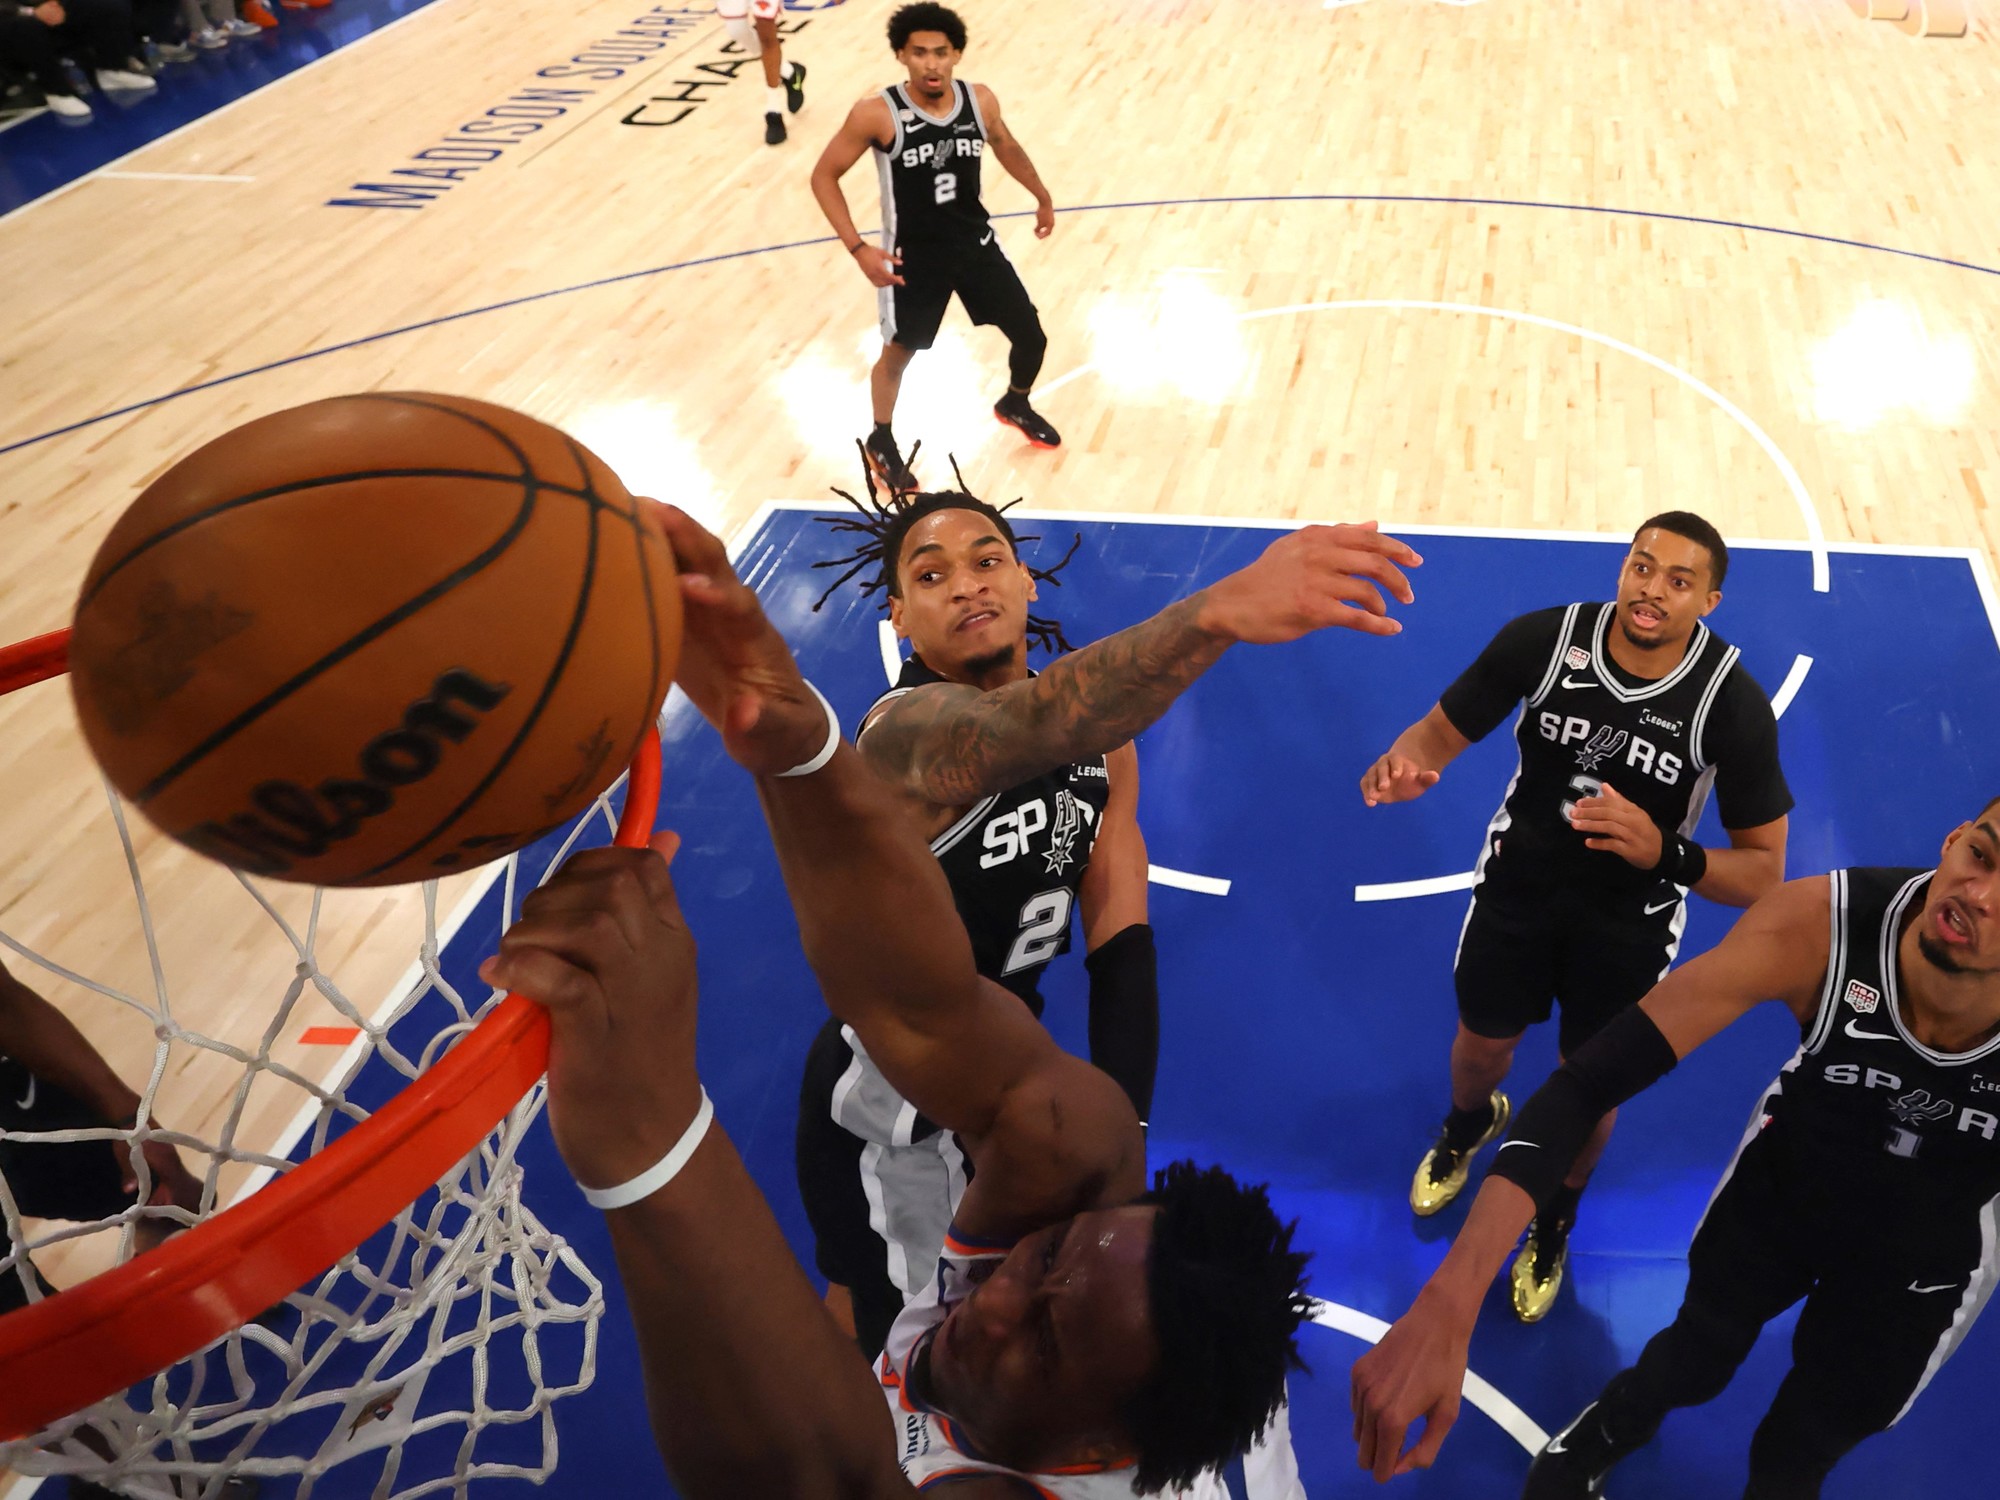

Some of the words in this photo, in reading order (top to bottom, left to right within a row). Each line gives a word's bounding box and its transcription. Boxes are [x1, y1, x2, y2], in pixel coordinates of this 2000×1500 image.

[323, 88, 597, 209] MADISON
[536, 6, 718, 80] SQUARE
[902, 138, 984, 168] SPURS
[934, 173, 957, 205] 2
[1645, 714, 1677, 732] LEDGER
[1539, 711, 1683, 786] SPURS
[1077, 765, 1107, 778] LEDGE
[979, 789, 1103, 877] SPU
[1001, 886, 1074, 978] 2
[1851, 984, 1876, 1000] USA
[1824, 1064, 1998, 1140] SPUR
[1979, 1080, 2000, 1093] LED
